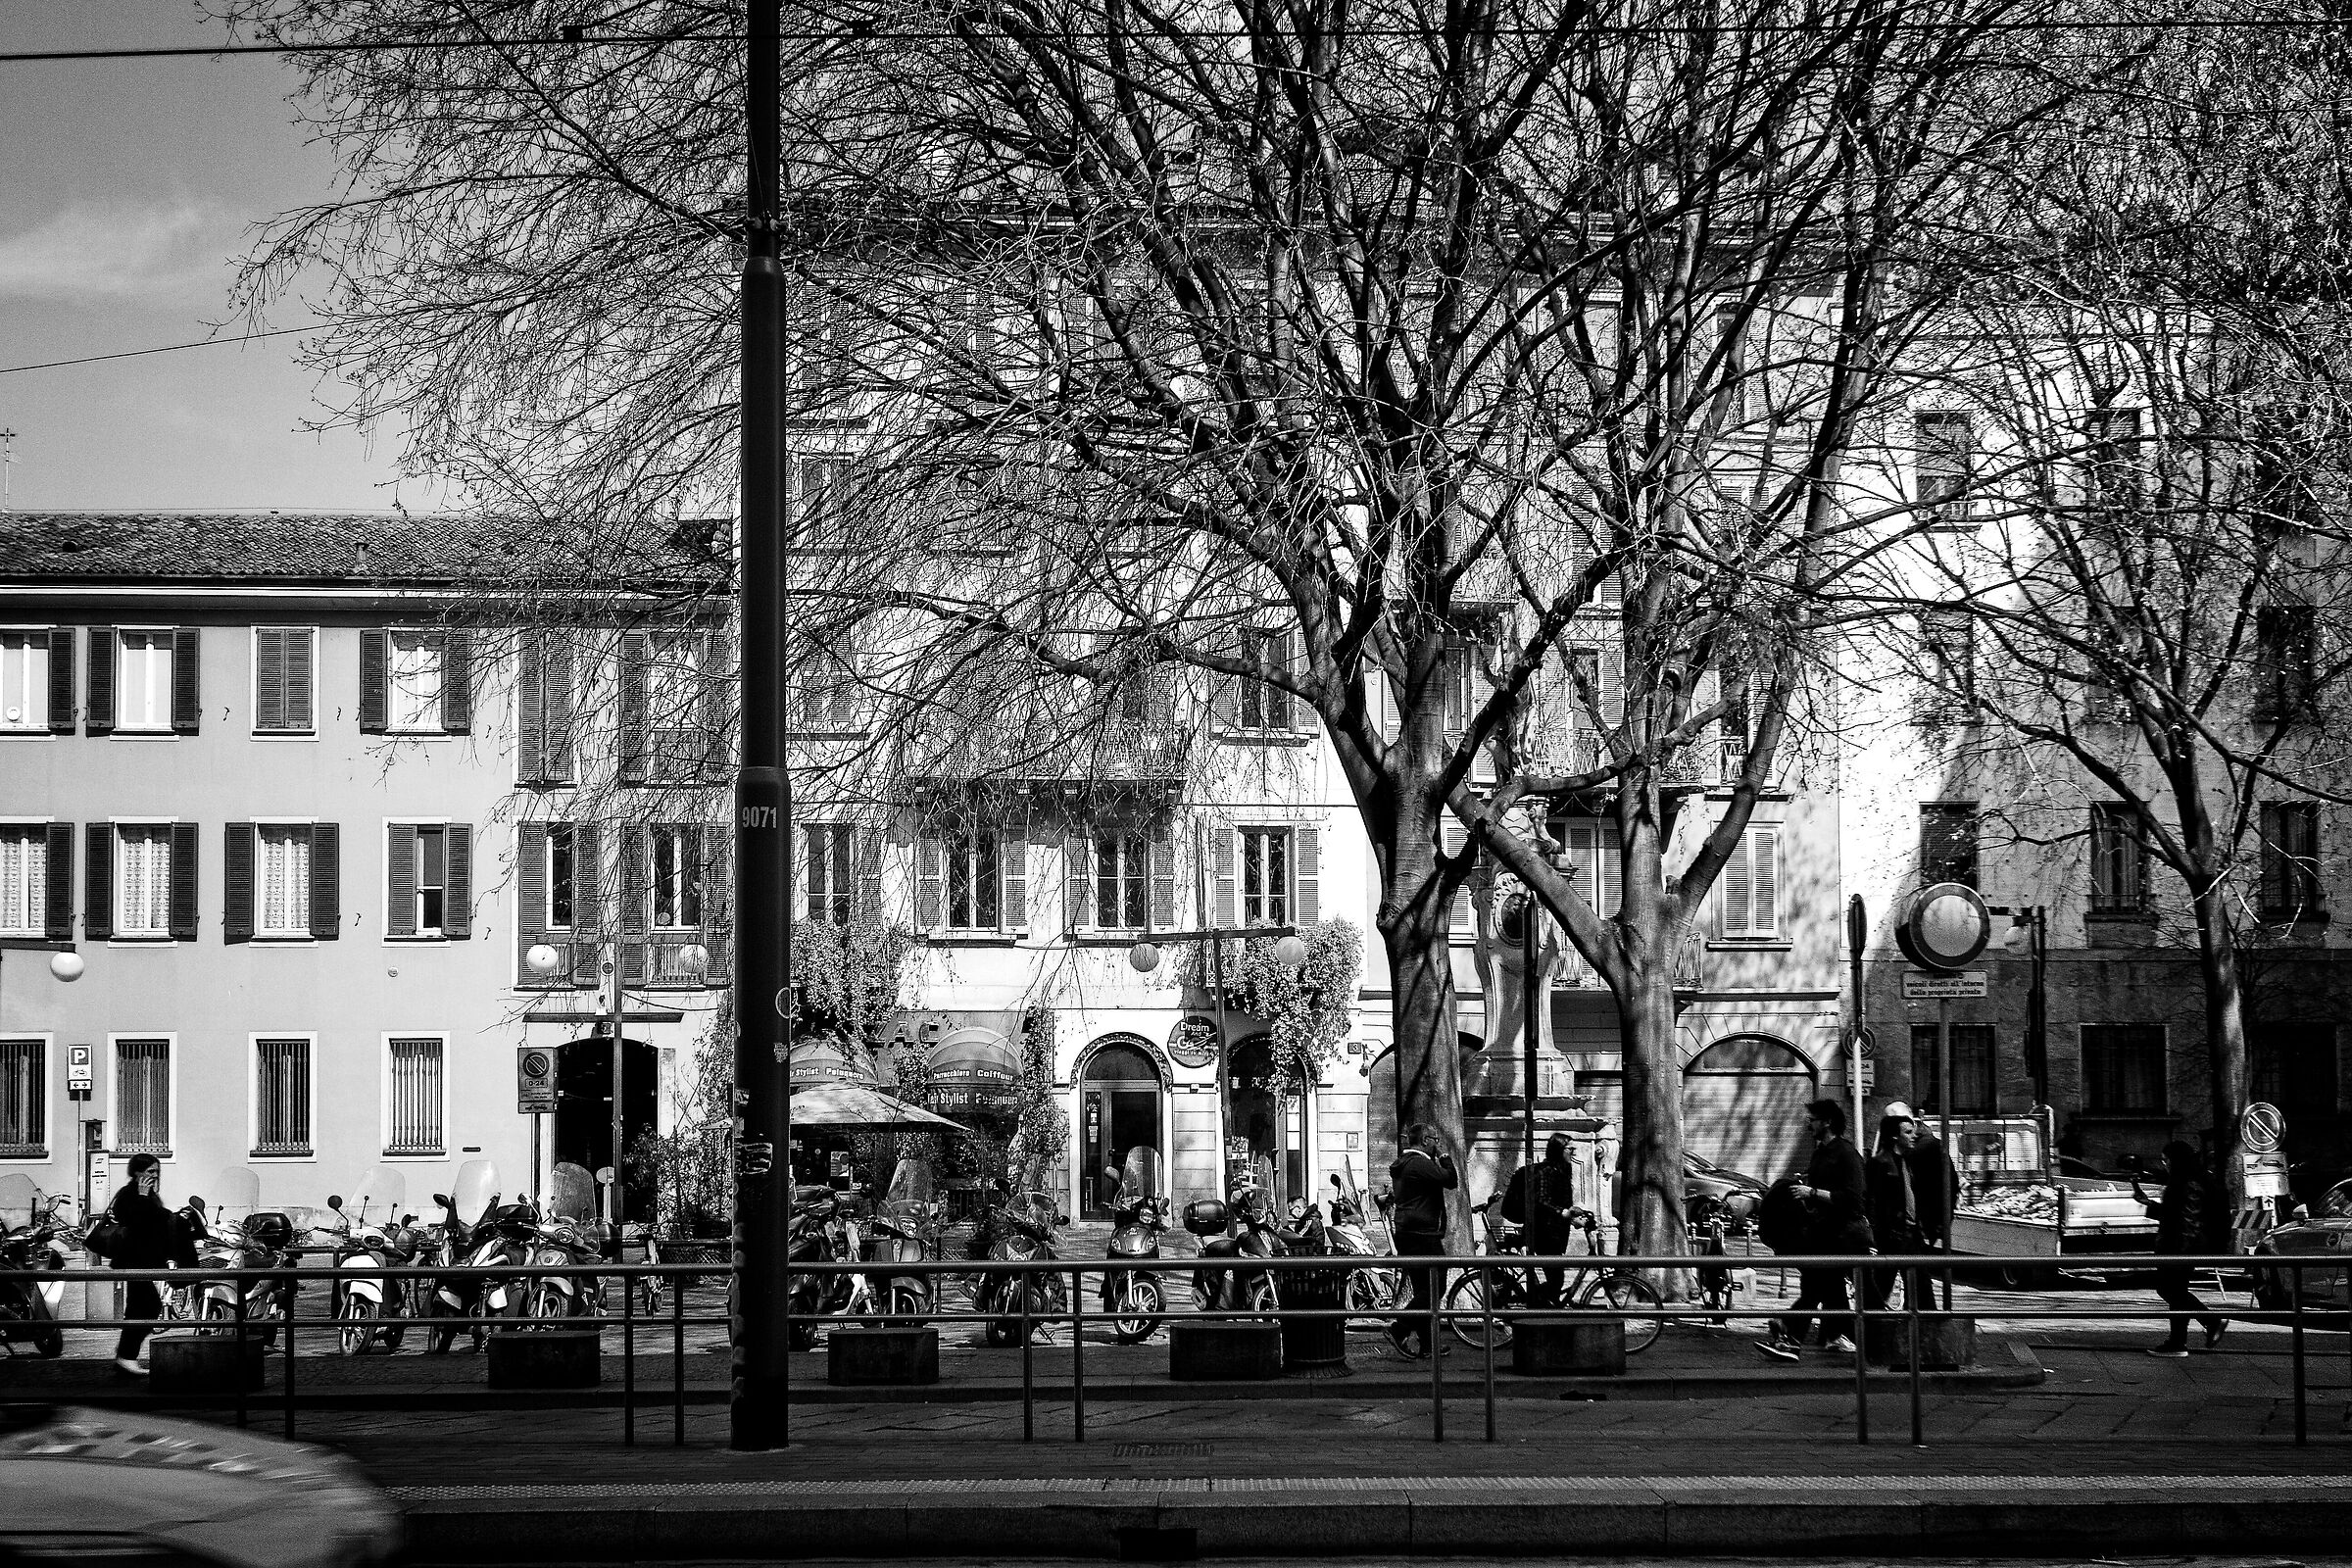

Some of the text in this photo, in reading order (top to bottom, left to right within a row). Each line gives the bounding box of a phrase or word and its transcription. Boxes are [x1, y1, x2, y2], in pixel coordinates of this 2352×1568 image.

[742, 806, 777, 828] 9071
[1180, 1021, 1209, 1032] Dream
[74, 1050, 86, 1064] P
[940, 1093, 969, 1106] Stylist
